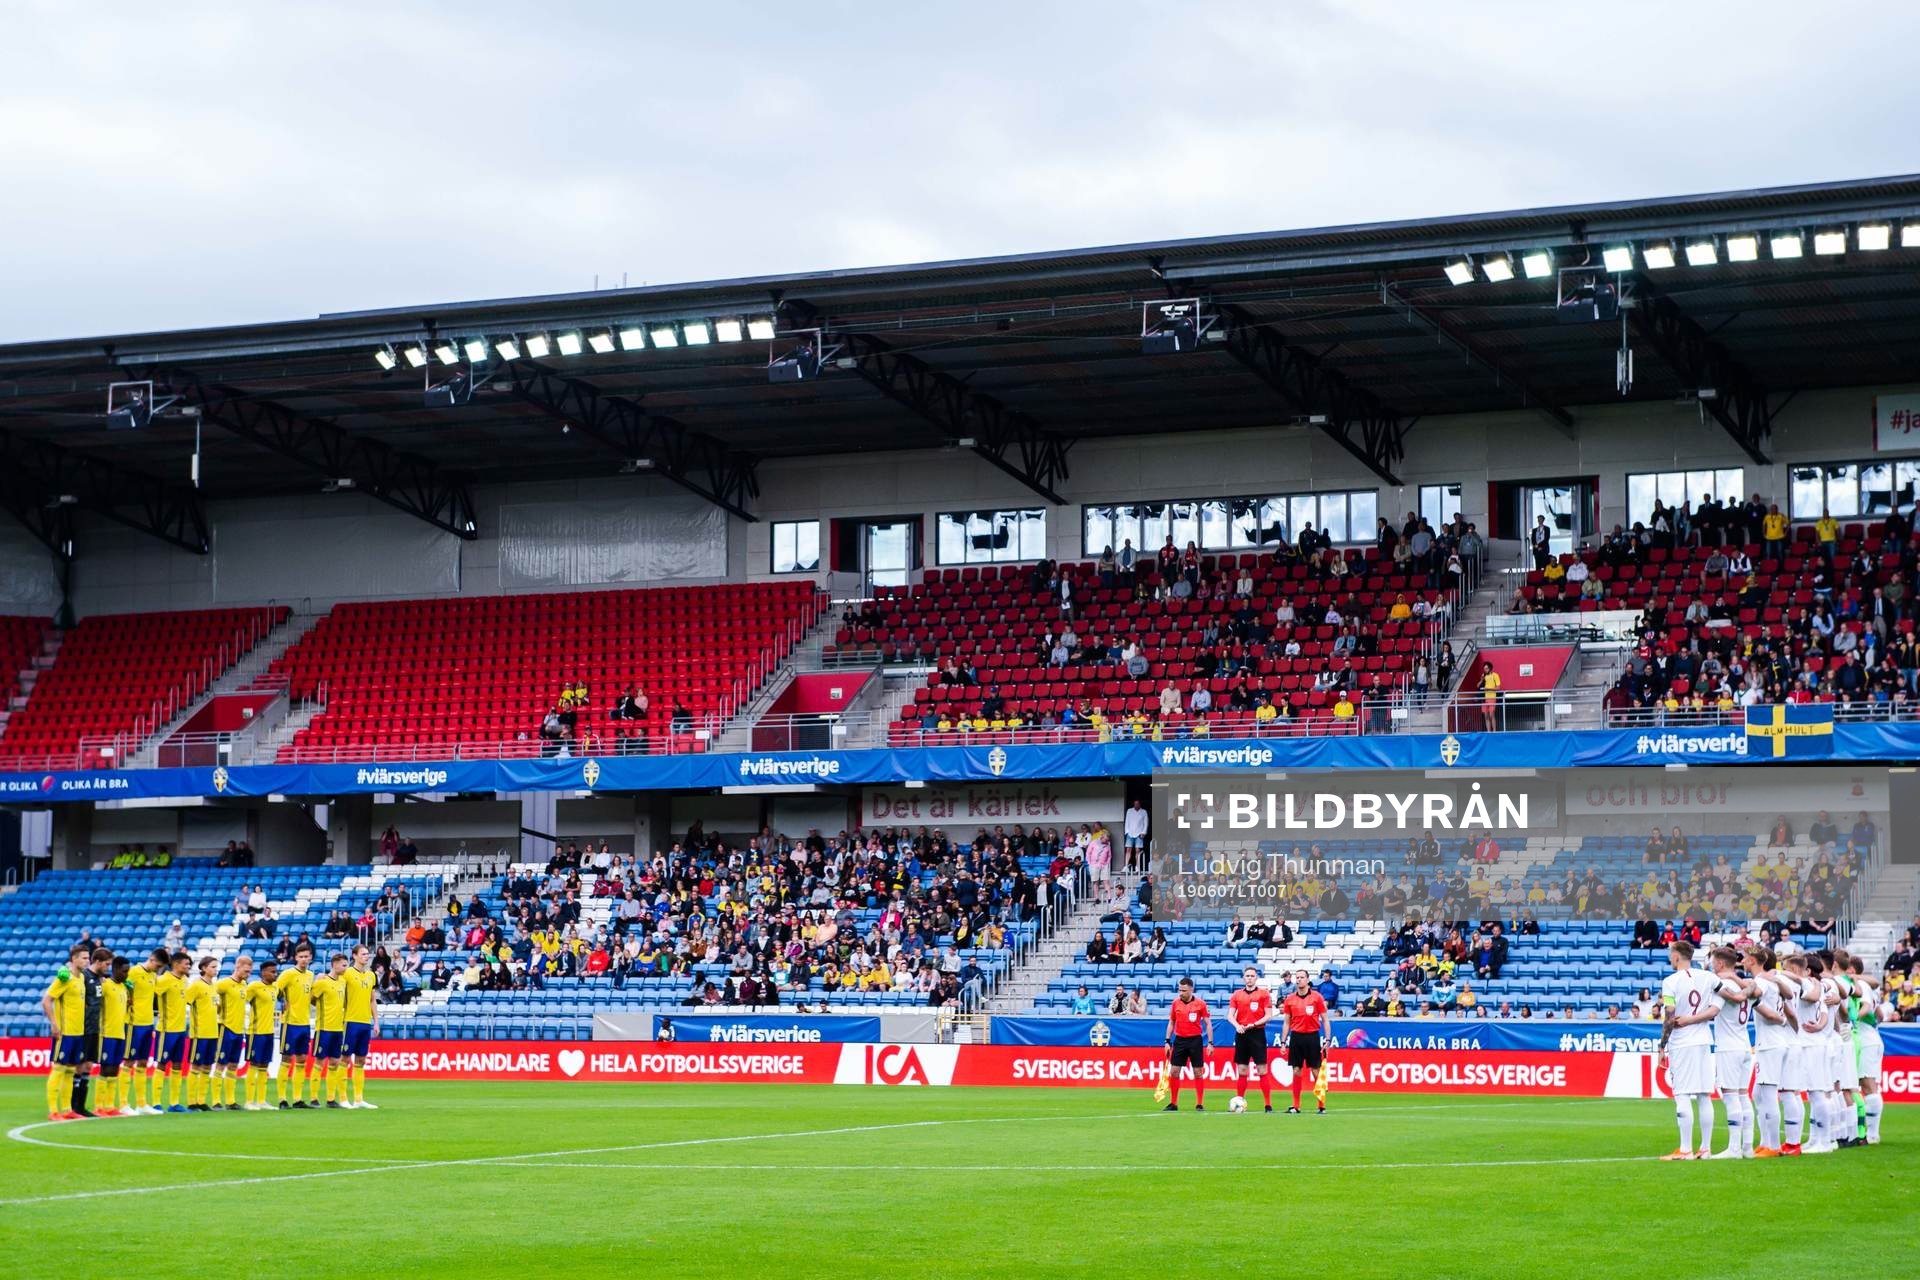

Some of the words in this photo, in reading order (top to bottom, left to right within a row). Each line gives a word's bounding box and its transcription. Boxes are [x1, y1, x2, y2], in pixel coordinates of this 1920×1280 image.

[1636, 733, 1747, 755] #viärsverig
[1162, 745, 1272, 766] #viärsverige
[357, 768, 447, 787] #viärsverige
[740, 757, 840, 777] #viärsverige
[9, 782, 37, 791] OLIKA
[62, 780, 91, 790] OLIKA
[94, 778, 106, 789] ÄR
[109, 779, 128, 788] BRA
[1586, 776, 1648, 806] och
[1661, 776, 1732, 806] bror
[872, 790, 920, 820] Det
[929, 791, 957, 818] är
[967, 786, 1060, 817] kärlek
[1688, 990, 1701, 1016] 9
[1378, 1036, 1422, 1049] OLIKA
[1427, 1036, 1446, 1050] ÄR
[1451, 1038, 1481, 1050] BRA
[1559, 1033, 1663, 1052] #viärsver
[352, 1052, 419, 1071] ERIGES
[422, 1052, 550, 1072] ICA-HANDLARE
[590, 1054, 638, 1073] HELA
[641, 1055, 804, 1075] FOTBOLLSSVERIGE
[865, 1045, 929, 1086] ICA
[1013, 1060, 1106, 1080] SVERIGES
[1109, 1060, 1261, 1081] ICA-HNDLAE
[1310, 1062, 1366, 1084] ELA
[1370, 1063, 1567, 1087] FOTBOLLSSVERIGE
